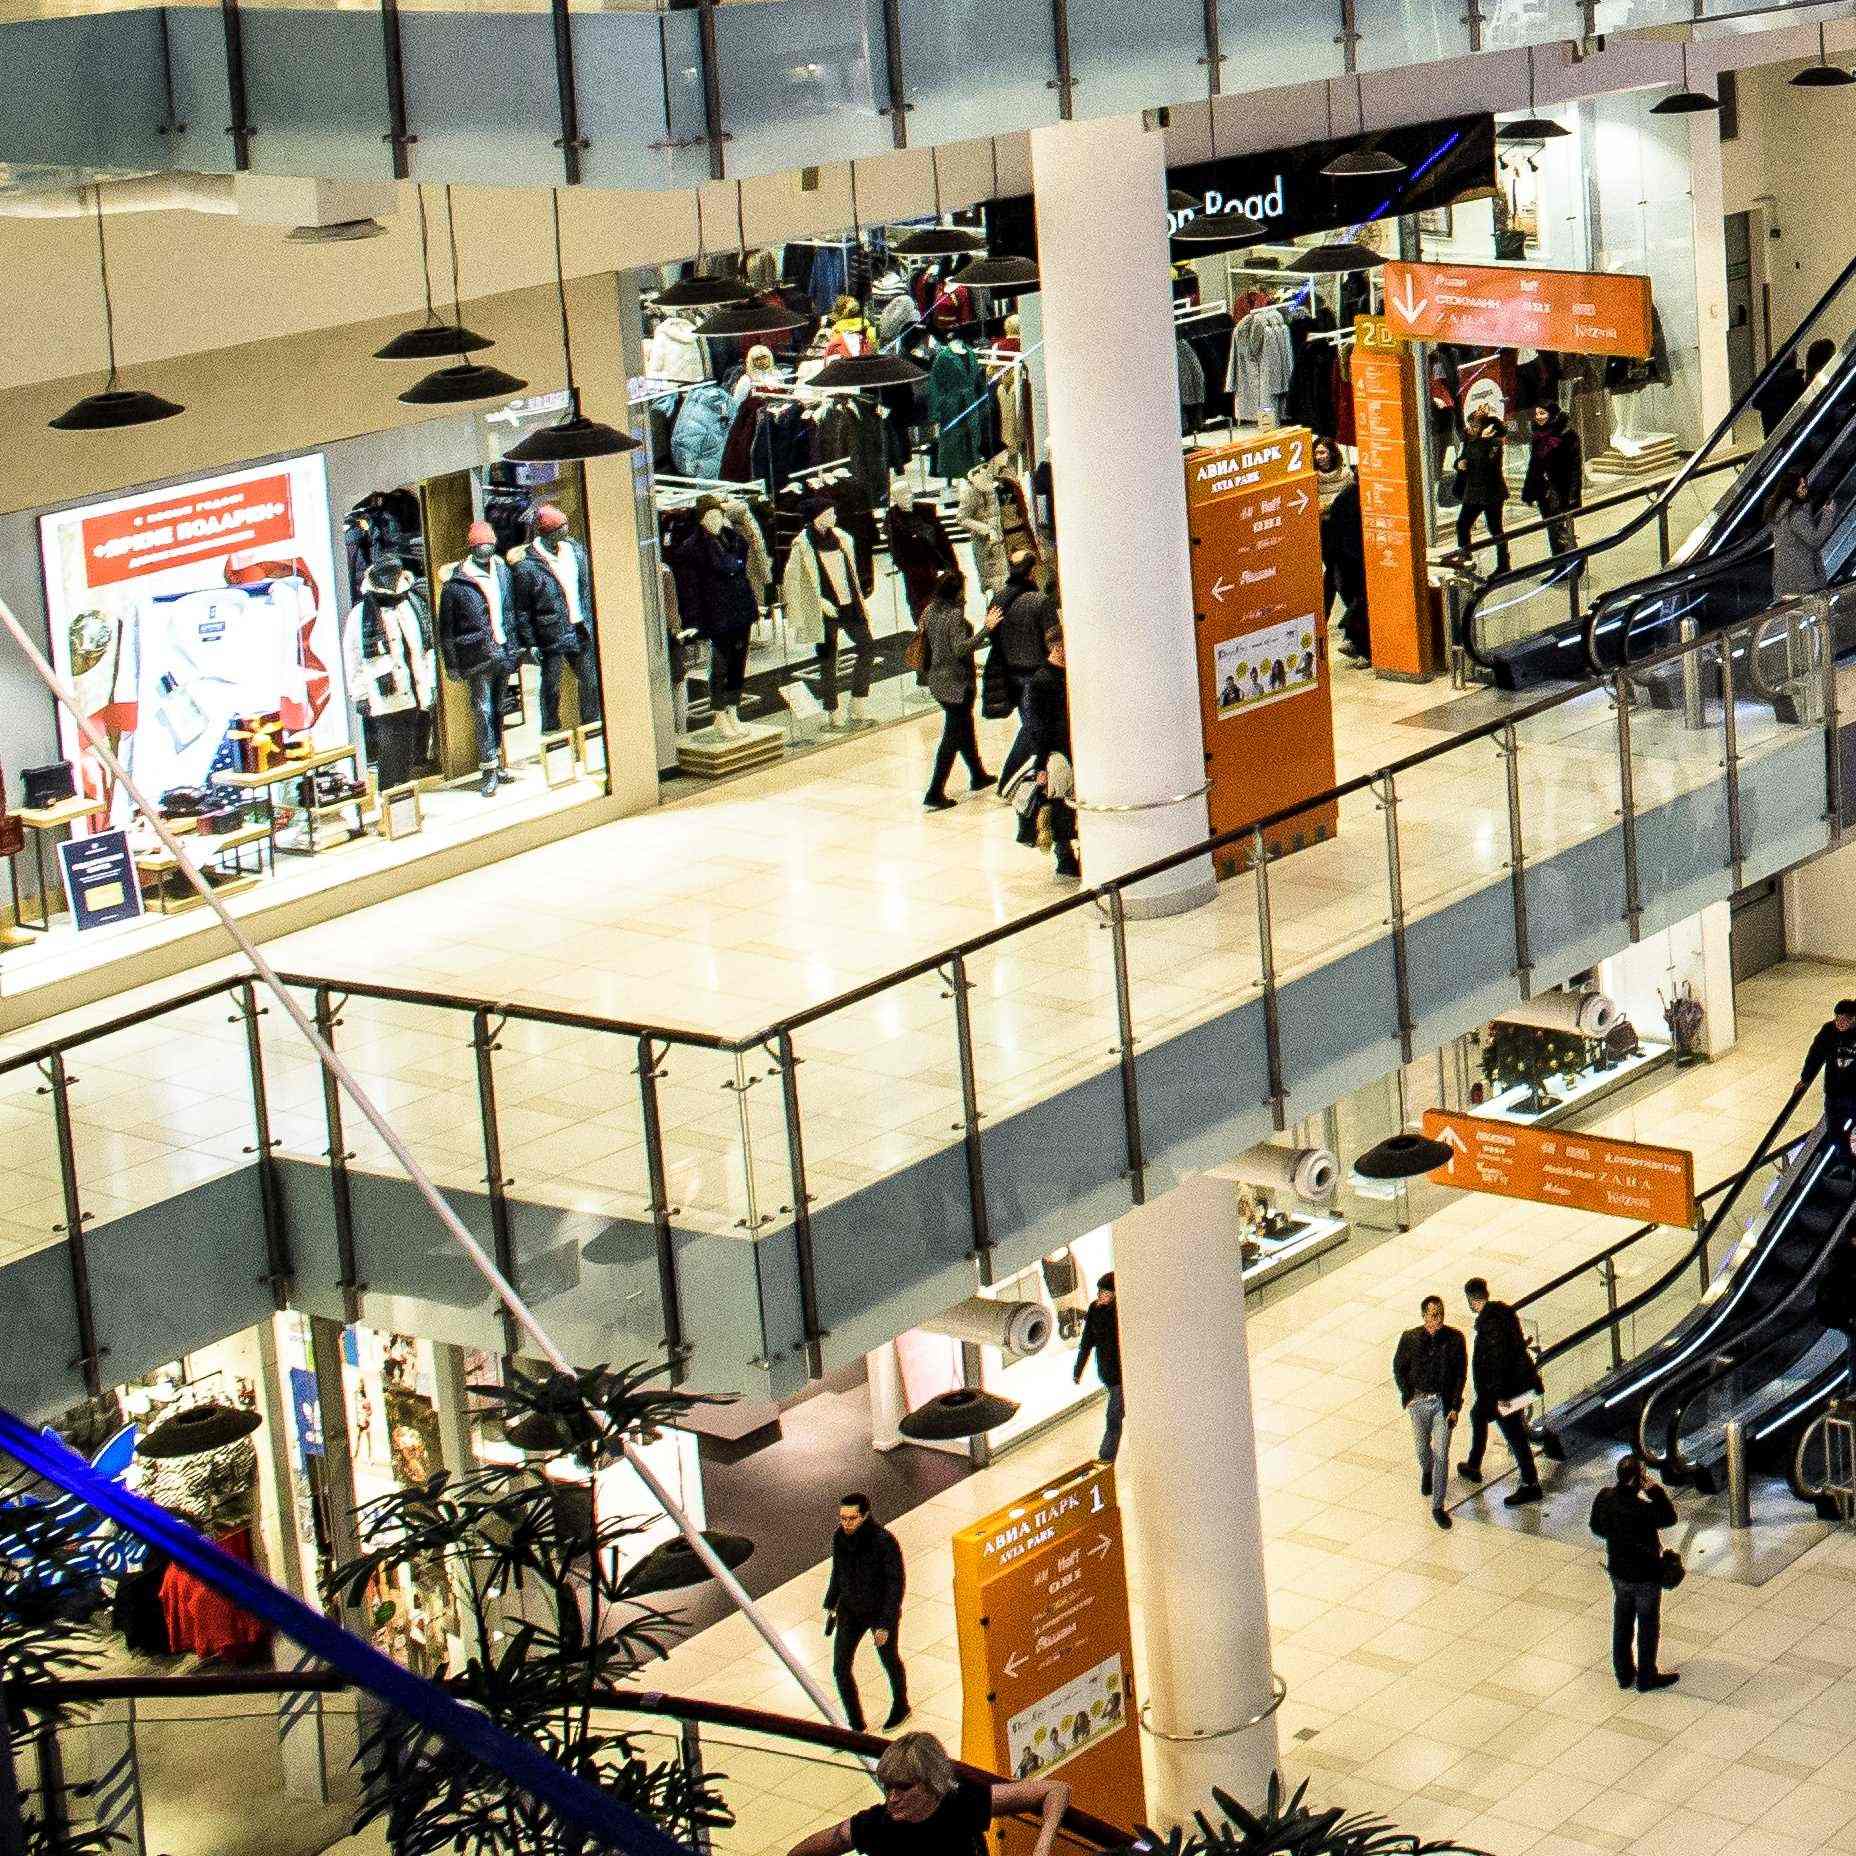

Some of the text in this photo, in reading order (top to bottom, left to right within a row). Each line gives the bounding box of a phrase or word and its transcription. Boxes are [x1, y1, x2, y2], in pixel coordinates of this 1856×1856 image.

[1197, 441, 1303, 482] АВИА ПАРК 2
[983, 1484, 1105, 1555] АВИА ПАРК 1
